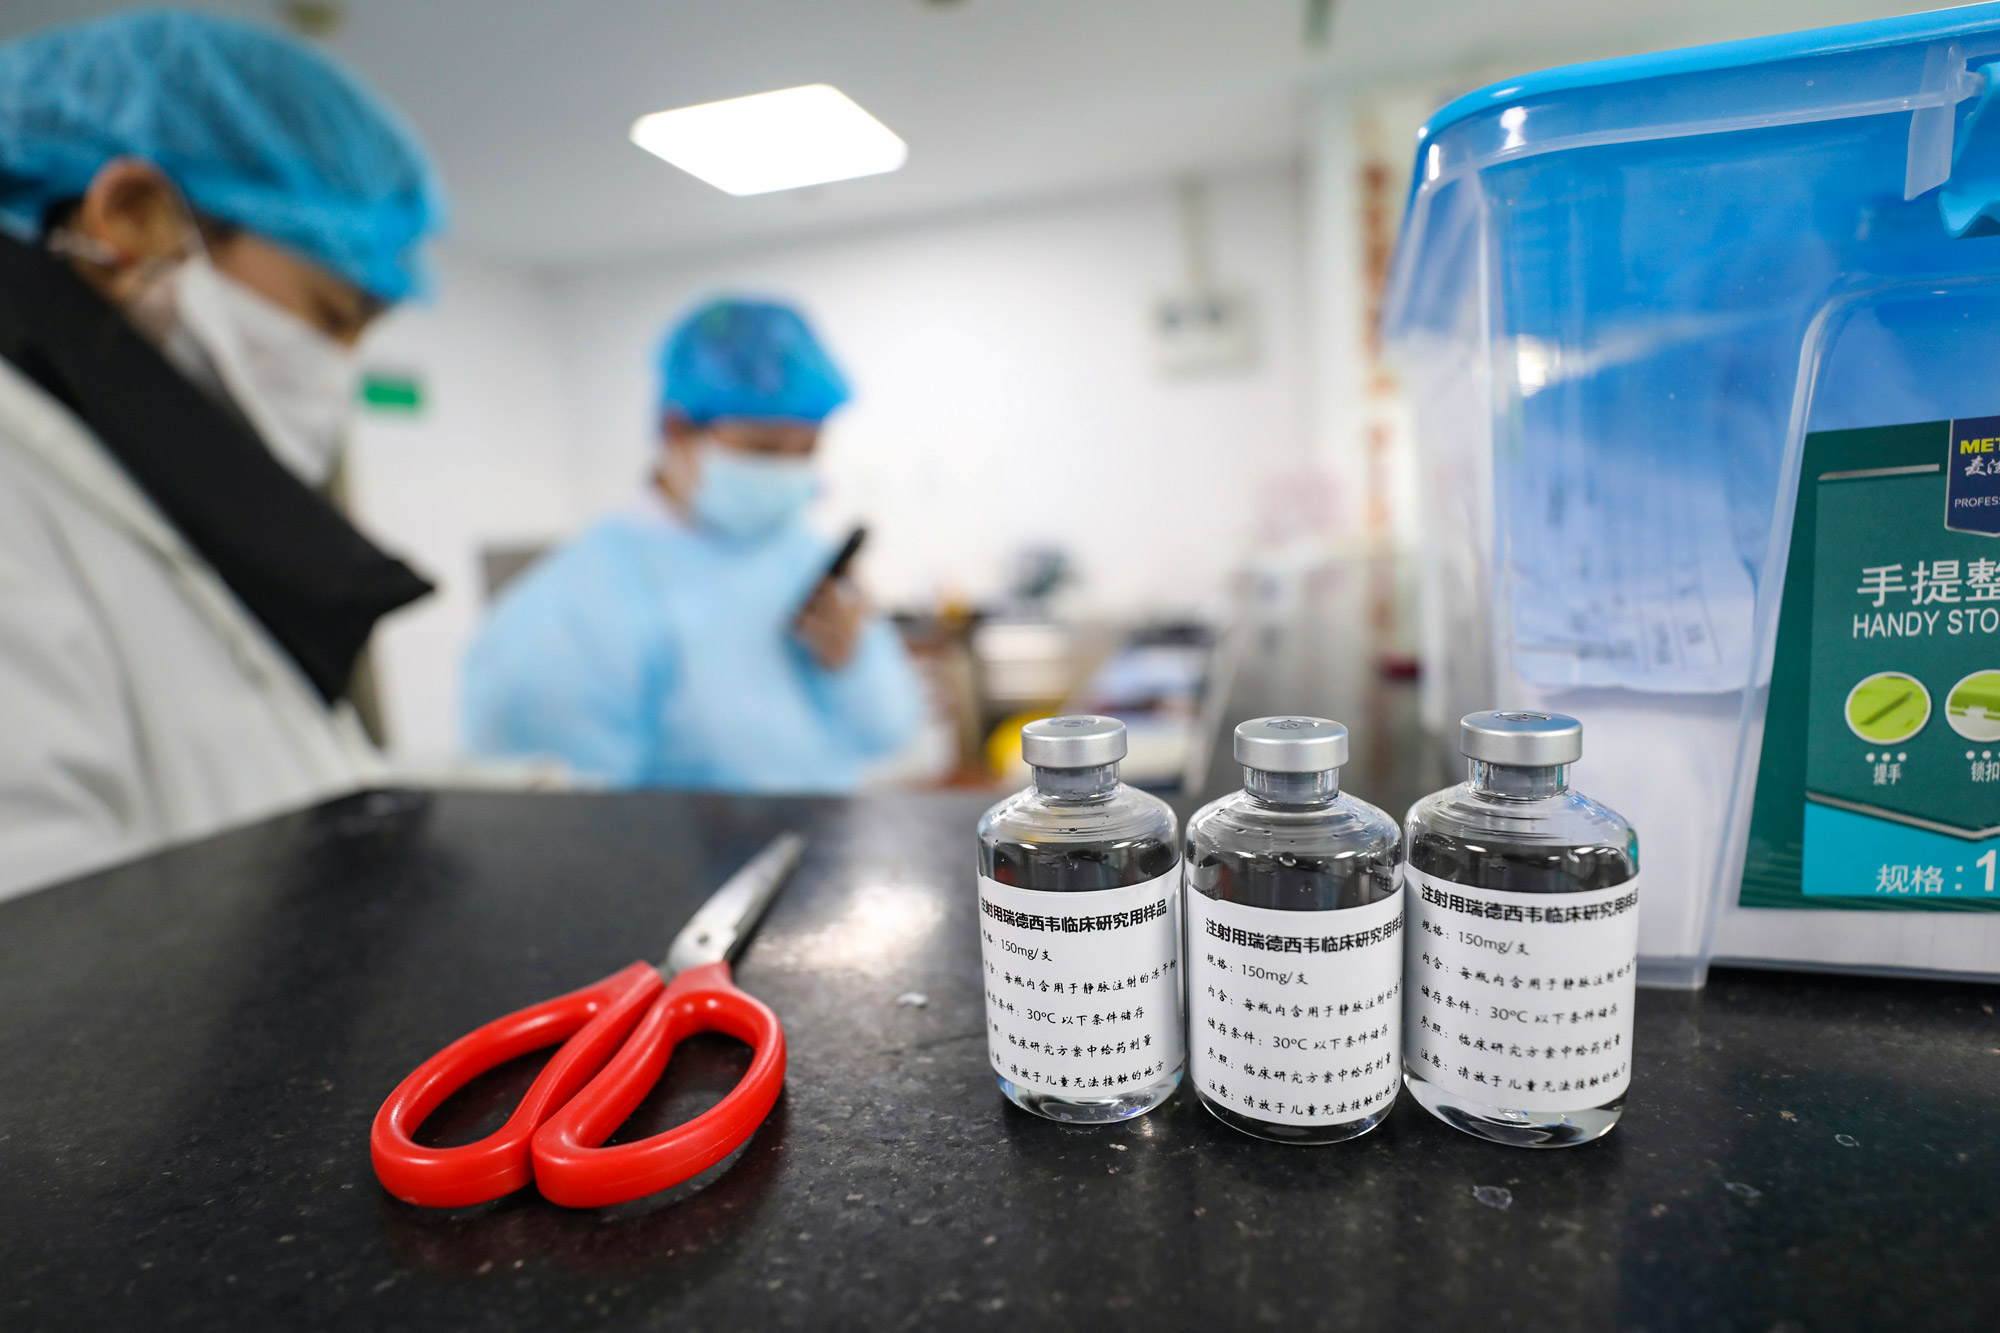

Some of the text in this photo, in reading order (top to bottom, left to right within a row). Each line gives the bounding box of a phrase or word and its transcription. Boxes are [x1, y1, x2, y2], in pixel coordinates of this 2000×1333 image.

[1954, 496, 2000, 508] PROFES
[1856, 557, 2000, 608] 手提整
[1853, 607, 1999, 639] HANDY STO
[1873, 763, 1901, 785] 提手
